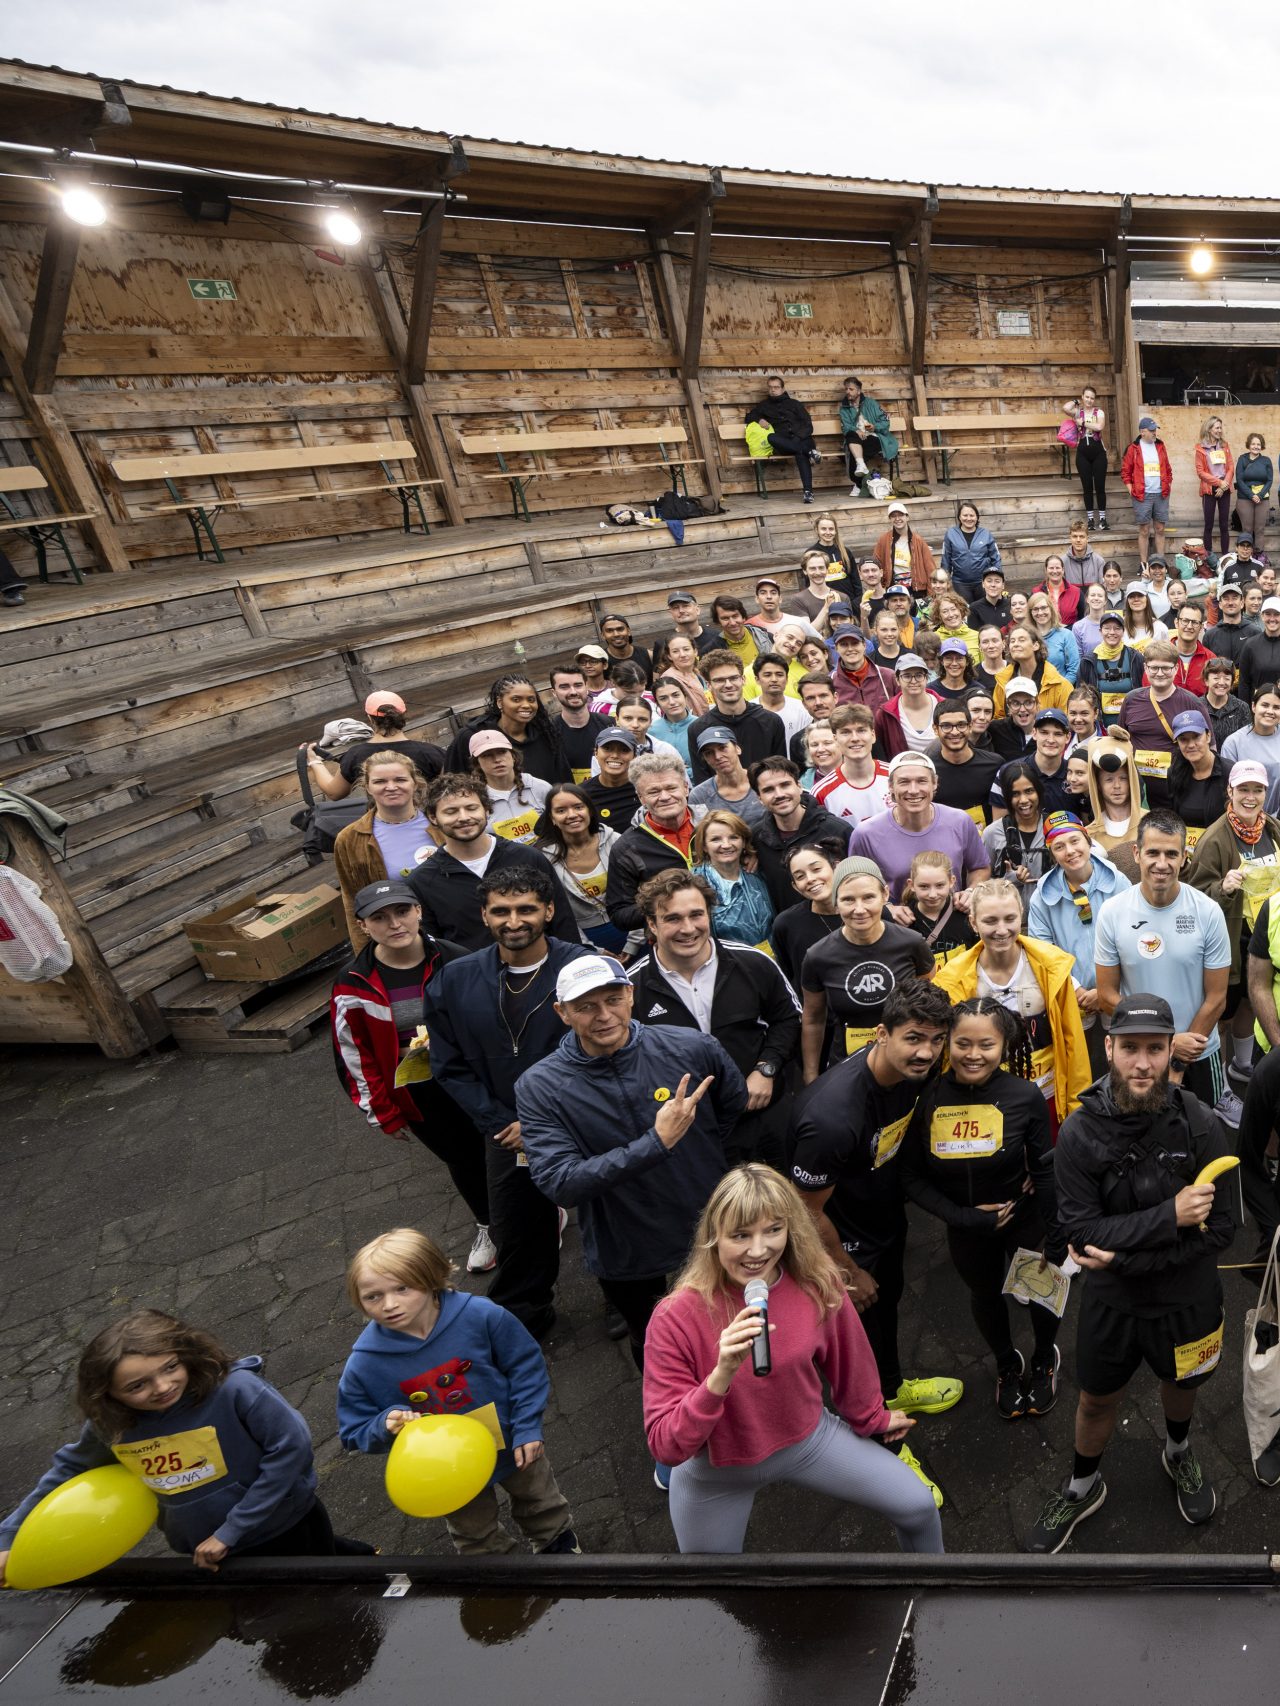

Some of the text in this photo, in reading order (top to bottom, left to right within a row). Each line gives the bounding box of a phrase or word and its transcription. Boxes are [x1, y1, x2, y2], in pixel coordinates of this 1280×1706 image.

[1145, 758, 1160, 768] 352
[511, 822, 531, 837] 399
[852, 973, 887, 994] AR
[952, 1120, 980, 1139] 475
[1198, 1340, 1220, 1365] 368
[141, 1451, 183, 1477] 225
